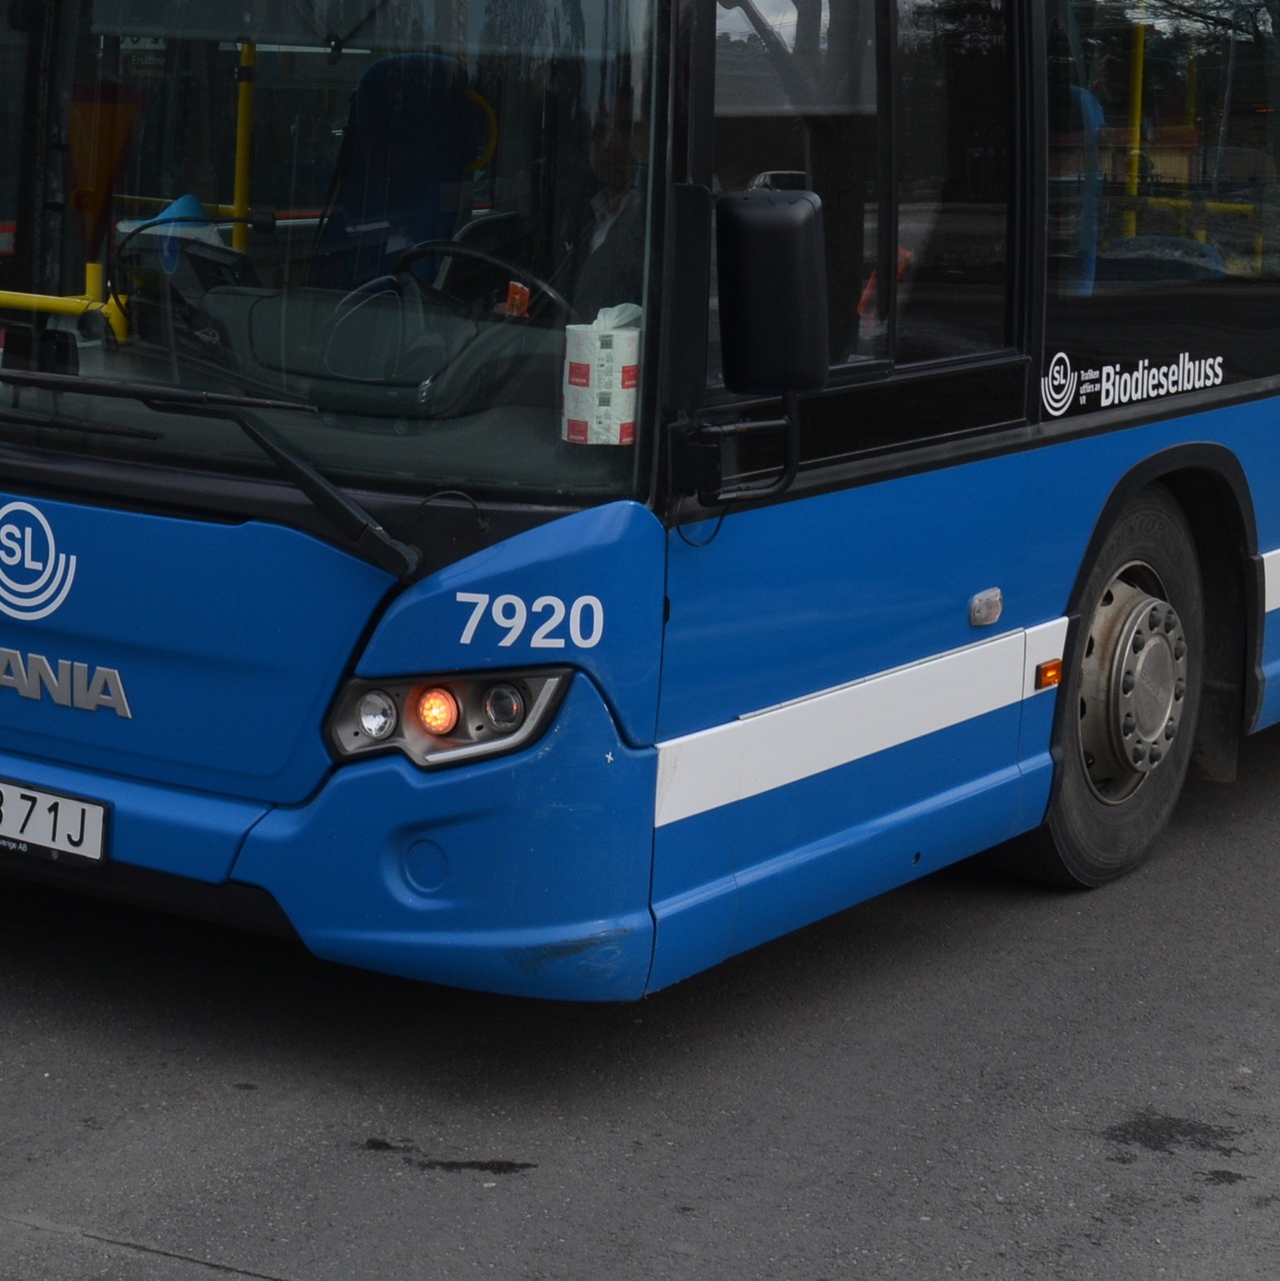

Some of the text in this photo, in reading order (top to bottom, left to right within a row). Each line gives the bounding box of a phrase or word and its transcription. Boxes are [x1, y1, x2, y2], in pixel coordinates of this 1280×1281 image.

[1100, 351, 1224, 408] Biodieselbuss
[455, 591, 604, 649] 7920
[17, 792, 87, 848] 71J
[18, 840, 28, 852] AB
